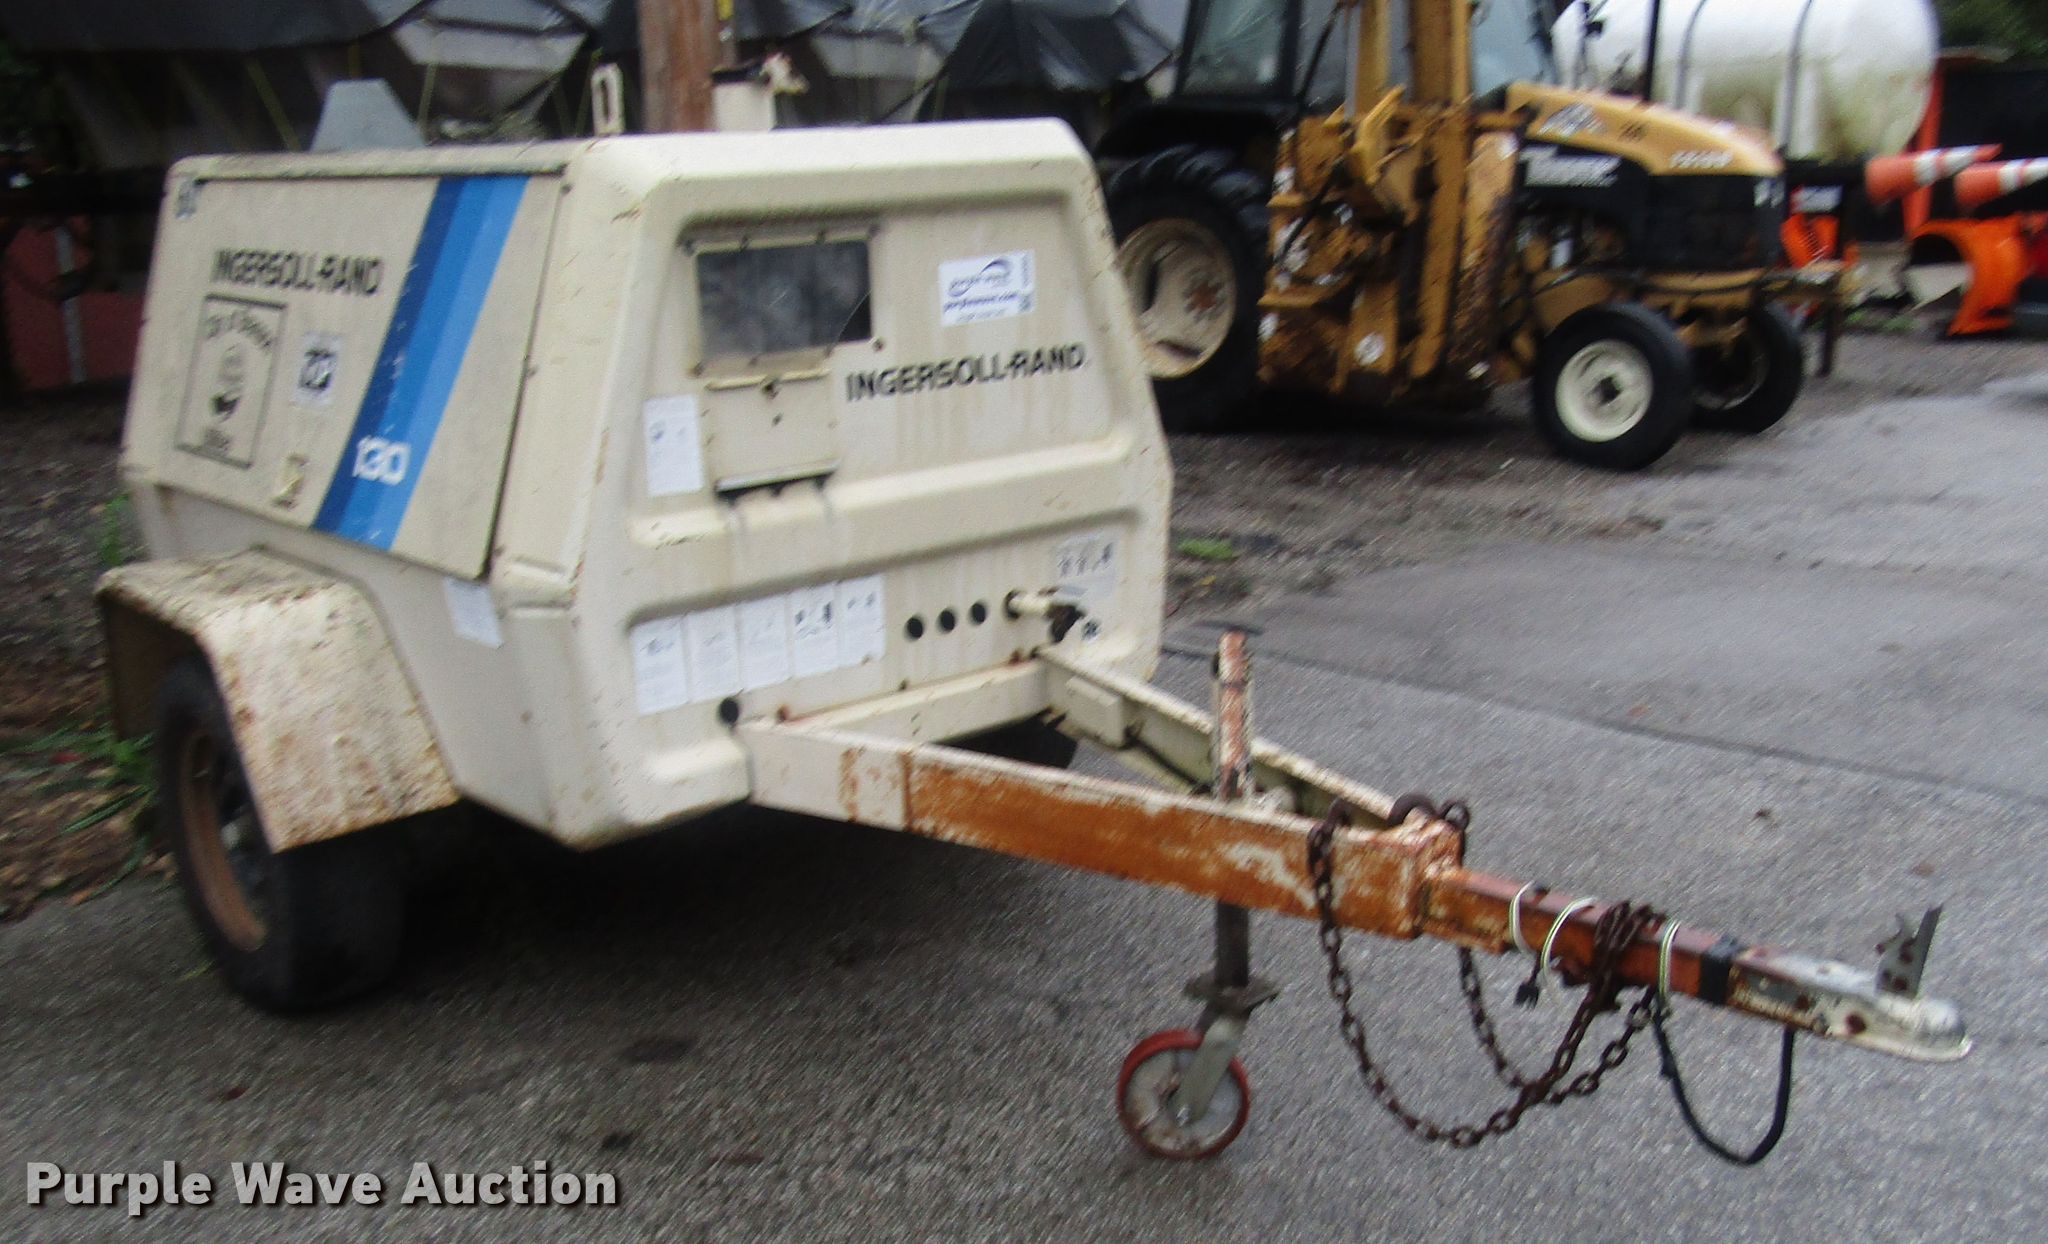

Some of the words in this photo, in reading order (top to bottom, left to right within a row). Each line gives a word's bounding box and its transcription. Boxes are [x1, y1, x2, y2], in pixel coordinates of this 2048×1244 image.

[213, 249, 383, 297] INGERSOLL-RAND
[846, 343, 1086, 402] INGERSOLL-RAND
[353, 435, 411, 486] 130
